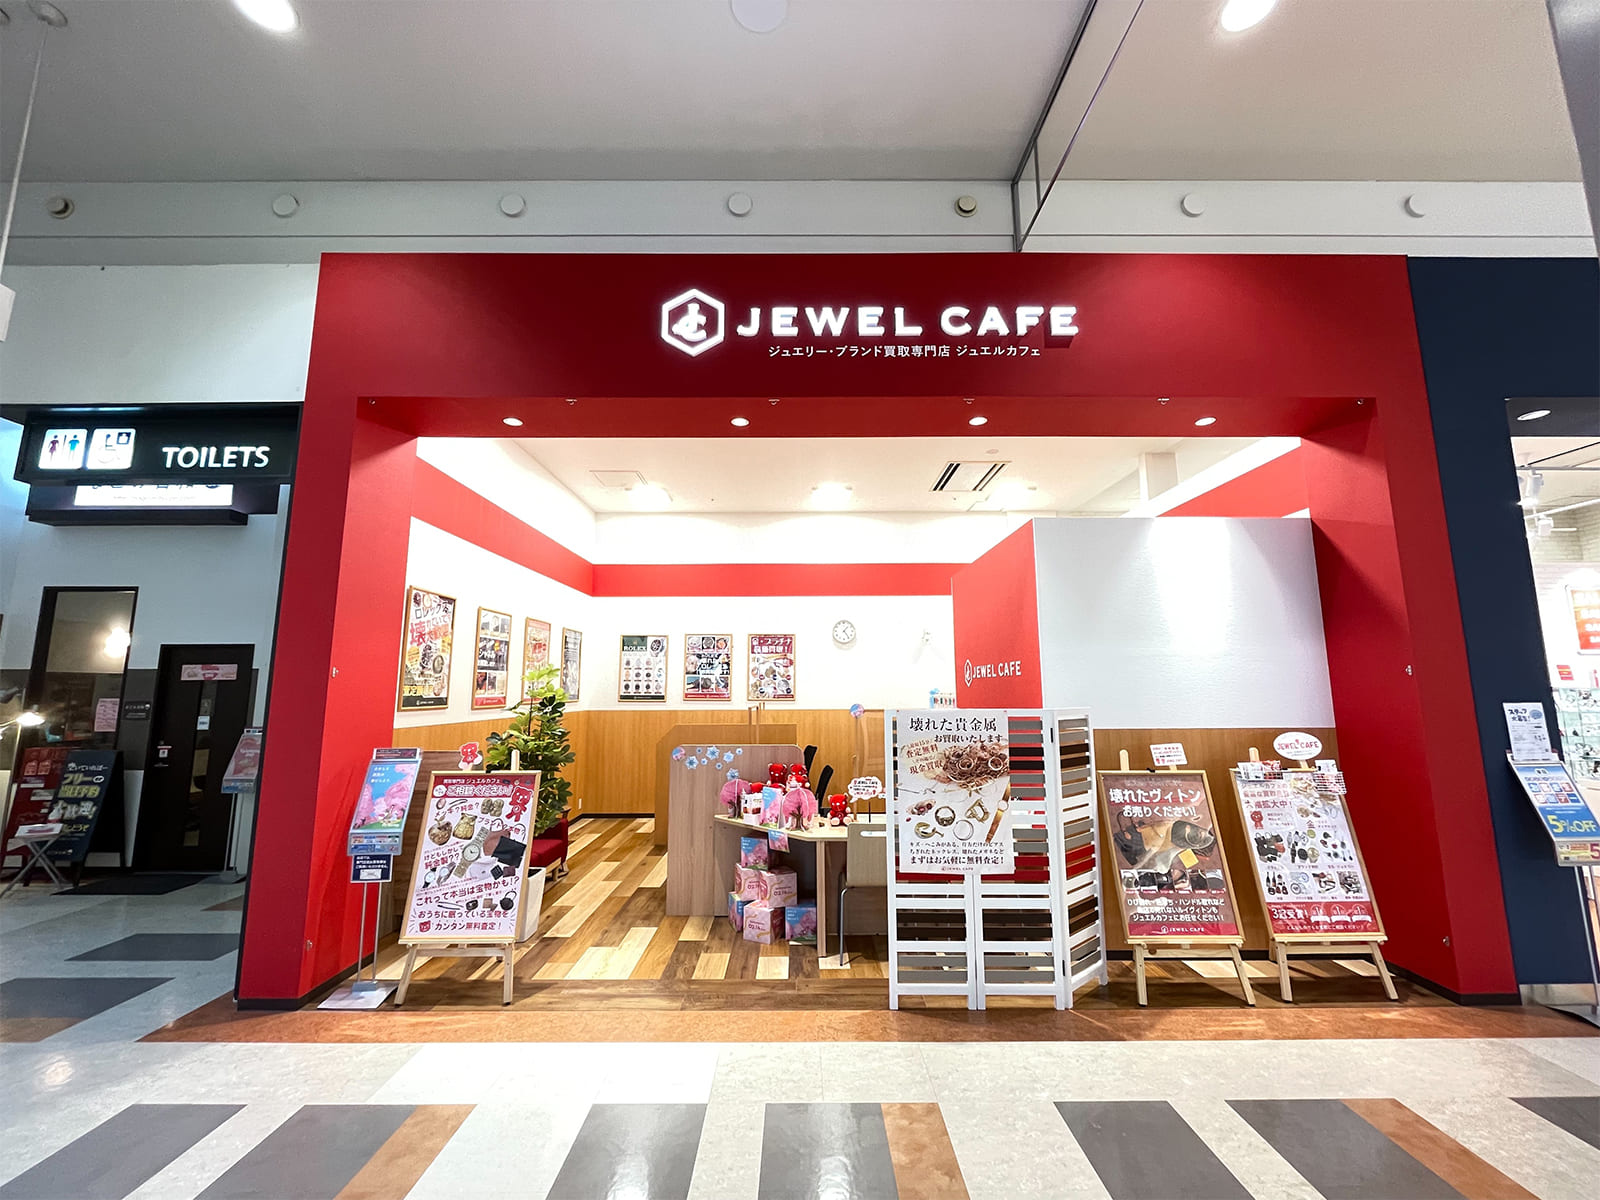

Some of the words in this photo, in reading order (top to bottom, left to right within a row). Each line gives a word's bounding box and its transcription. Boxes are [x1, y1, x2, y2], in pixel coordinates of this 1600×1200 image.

[736, 306, 923, 337] JEWEL
[940, 306, 1079, 337] CAFE
[768, 344, 950, 358] ジュエリー・ブランド買取専門店
[956, 344, 1041, 357] ジュエルカフェ
[161, 446, 271, 469] TOILETS
[972, 664, 997, 679] JEWEL
[998, 660, 1022, 677] CAFE
[910, 717, 997, 732] 壊れた貴金属
[934, 734, 1003, 744] お買取いたします
[1277, 742, 1298, 750] JEWEL
[1300, 741, 1320, 749] CAFE
[906, 743, 938, 758] 査定無料
[910, 760, 943, 774] 現金買取
[1109, 788, 1201, 803] 壊れたヴィトン
[1546, 814, 1598, 834] 5%OFF
[910, 856, 1004, 864] まずはお気軽に無料査定！
[418, 910, 509, 918] おうちに眠っている宝物を
